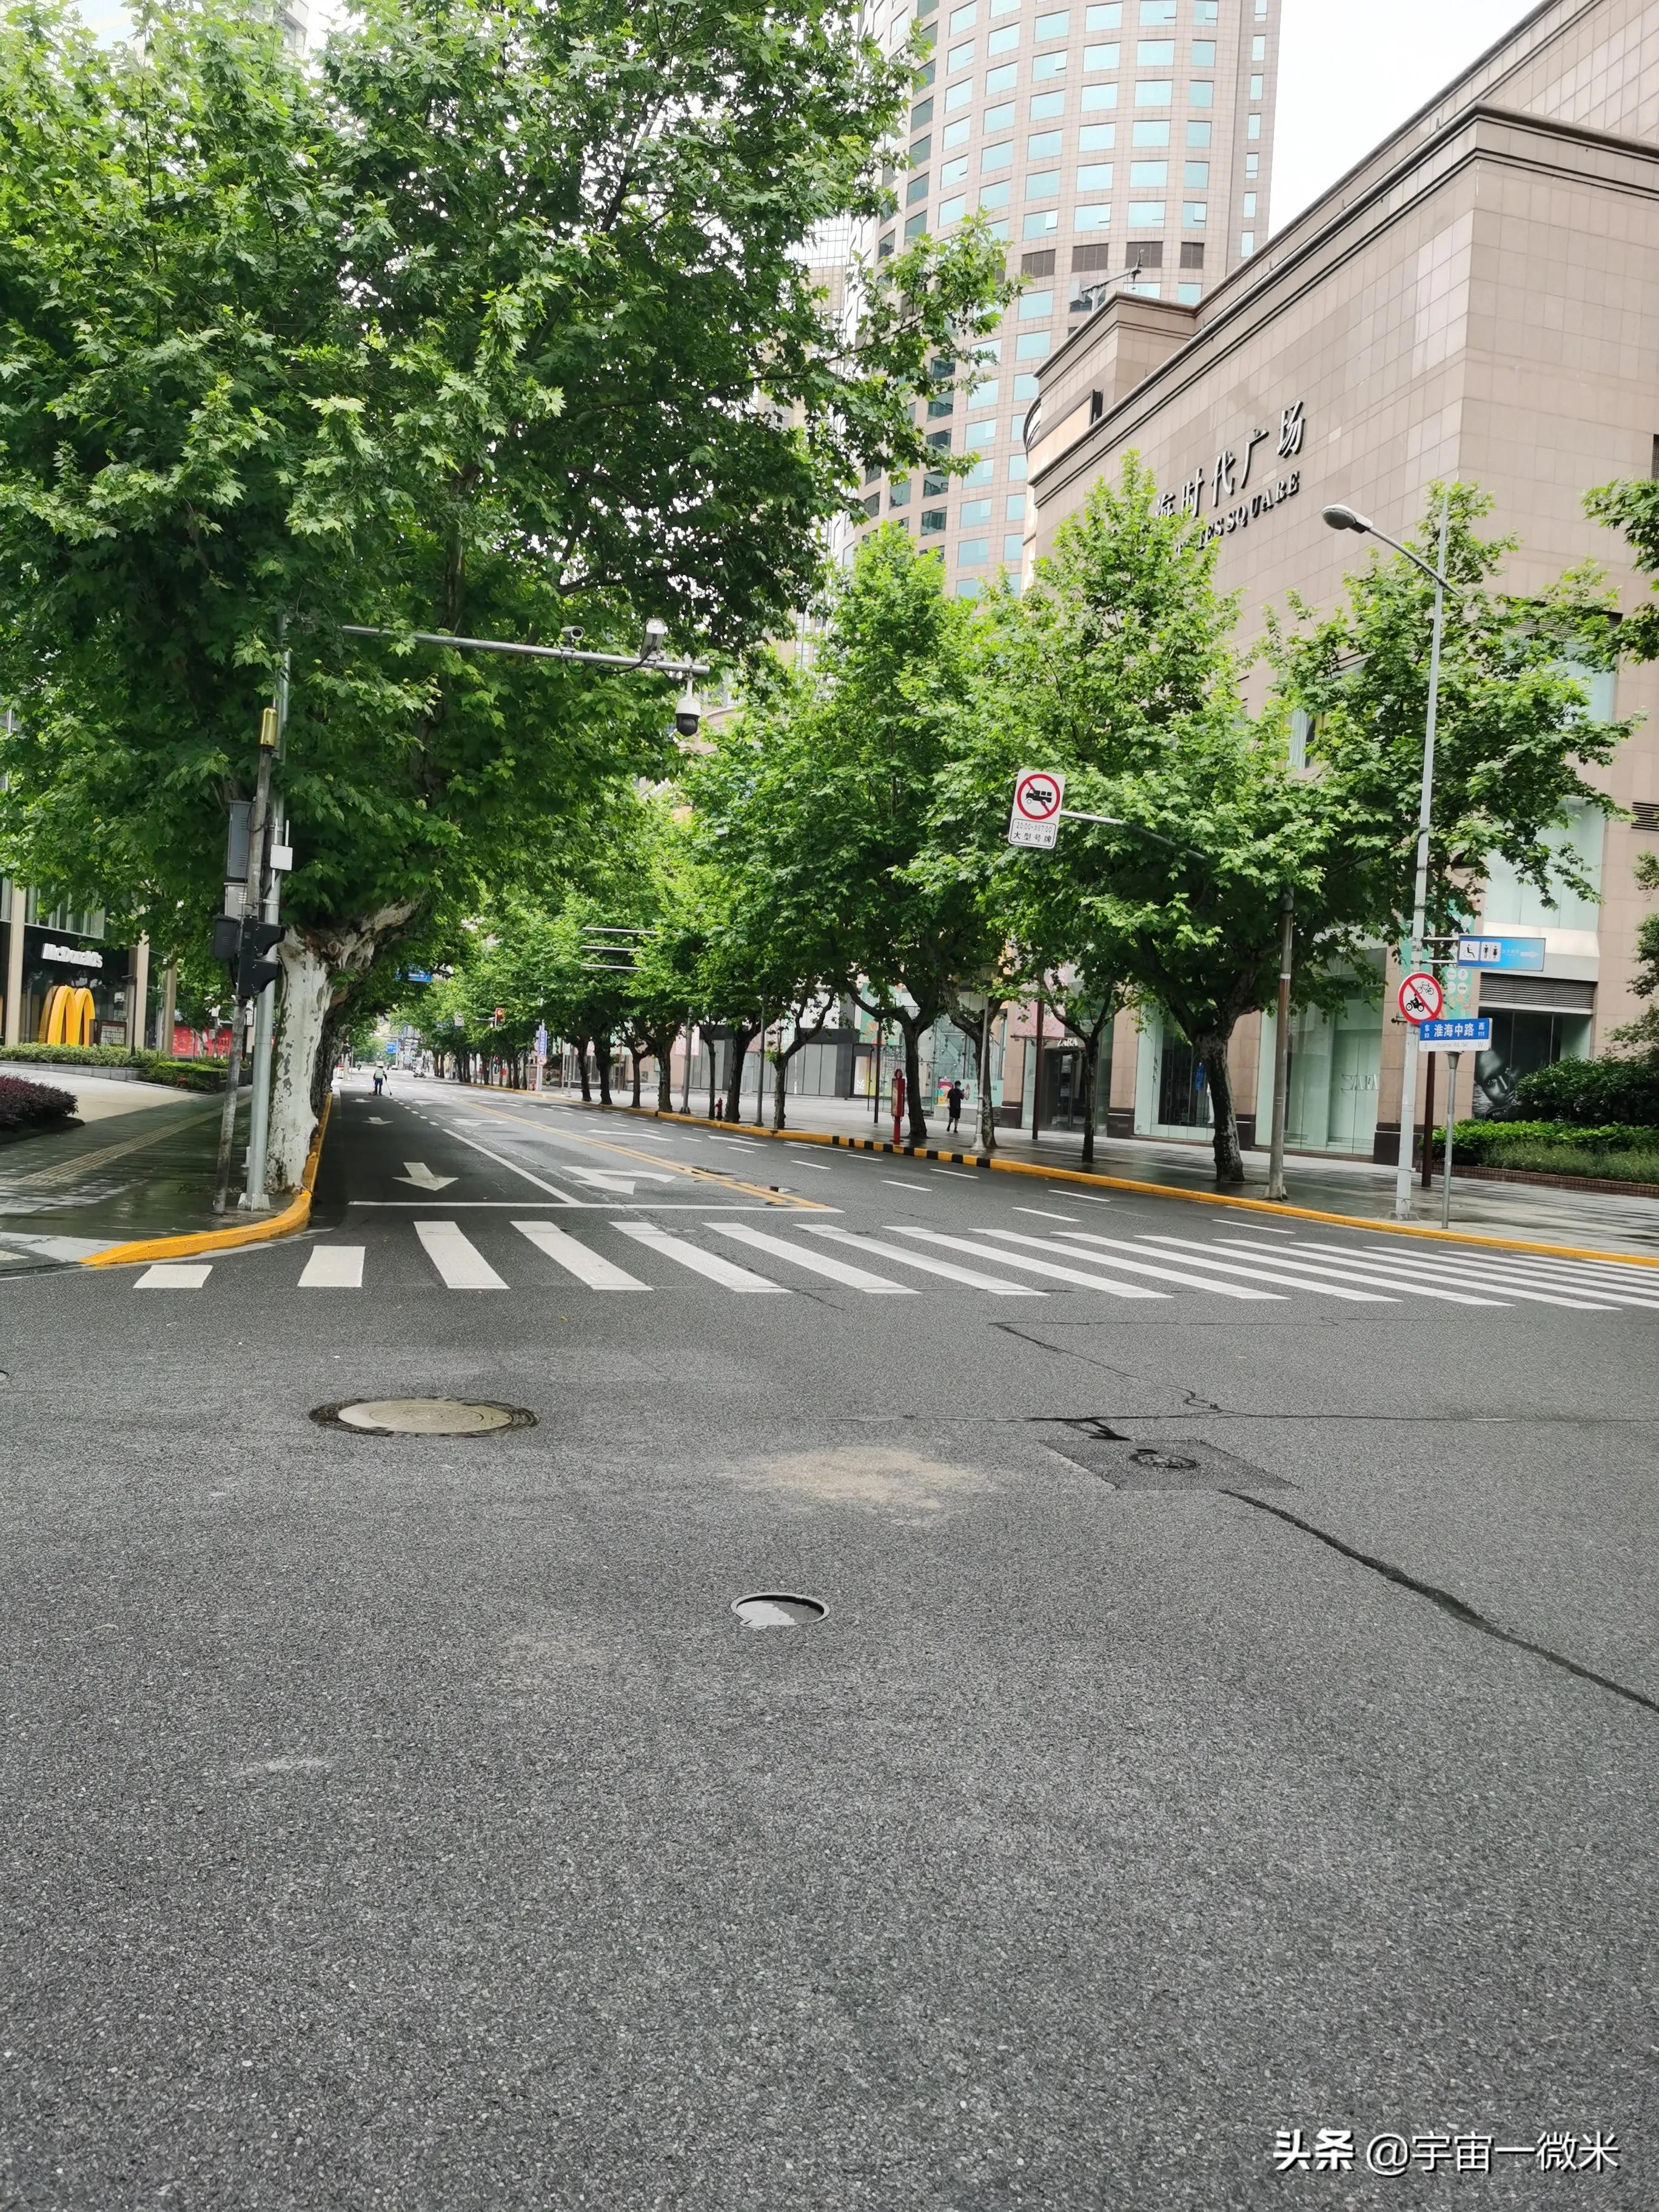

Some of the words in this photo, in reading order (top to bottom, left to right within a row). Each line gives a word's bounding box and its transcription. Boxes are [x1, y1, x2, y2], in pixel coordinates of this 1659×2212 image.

[1155, 400, 1305, 519] 海时代广场
[1227, 471, 1300, 533] SQUARE
[1014, 831, 1051, 843] 大型号牌
[41, 943, 103, 968] McDonald's
[1434, 1023, 1475, 1037] 淮海中路
[1057, 1037, 1079, 1047] ZARA
